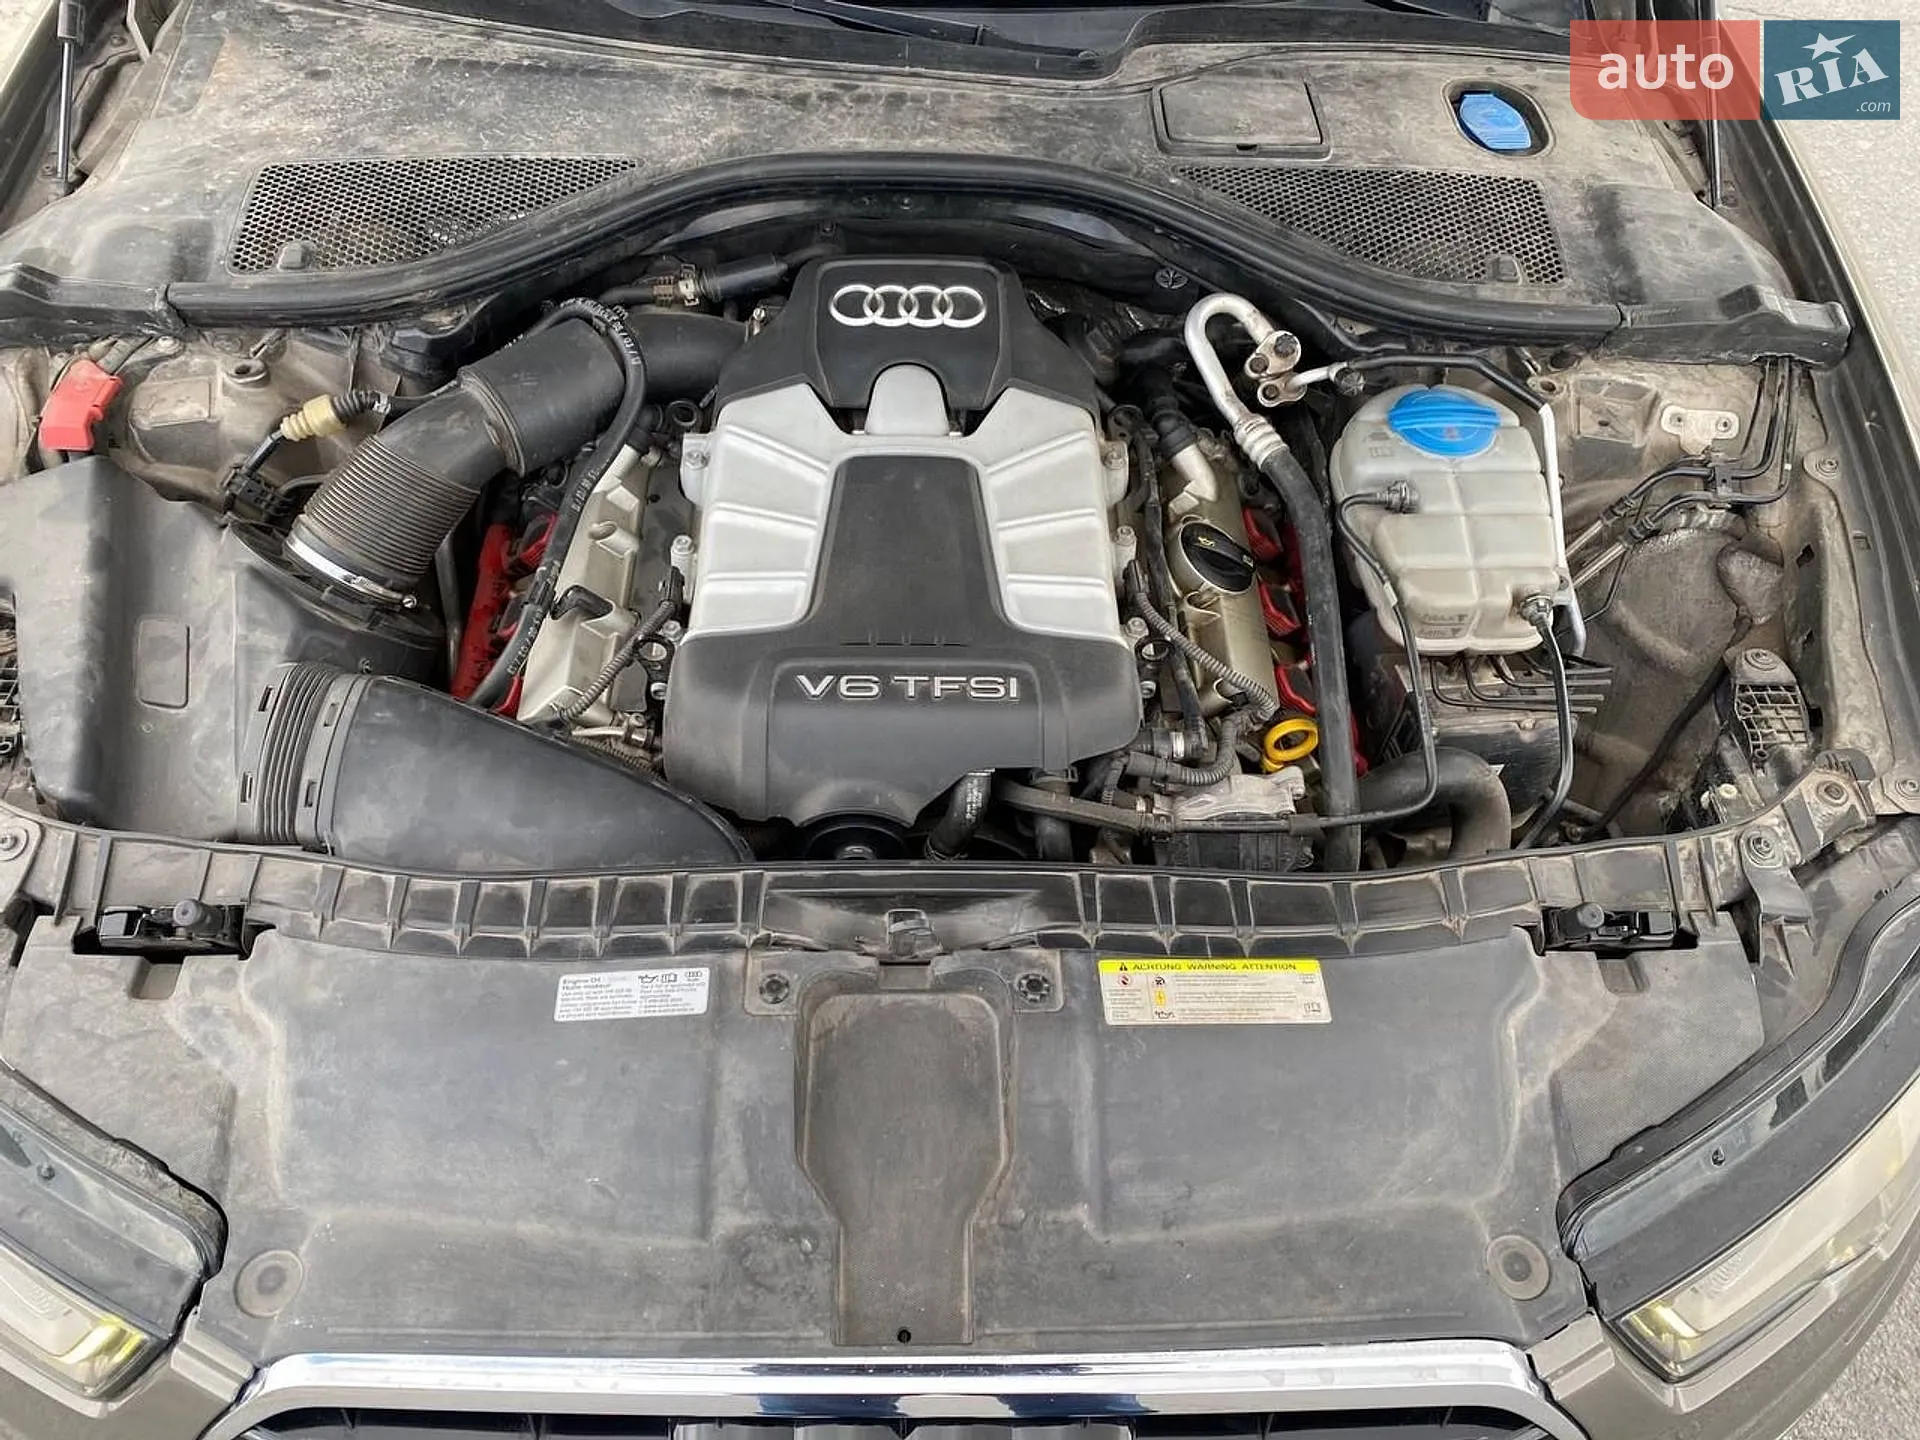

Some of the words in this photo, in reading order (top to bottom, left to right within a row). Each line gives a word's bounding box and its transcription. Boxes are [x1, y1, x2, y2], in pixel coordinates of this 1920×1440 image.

[796, 674, 881, 699] V6
[892, 675, 1019, 699] TFSI
[1132, 963, 1182, 971] ACHTUNG
[1186, 963, 1237, 971] WARNING
[1242, 963, 1297, 971] ATTENTION
